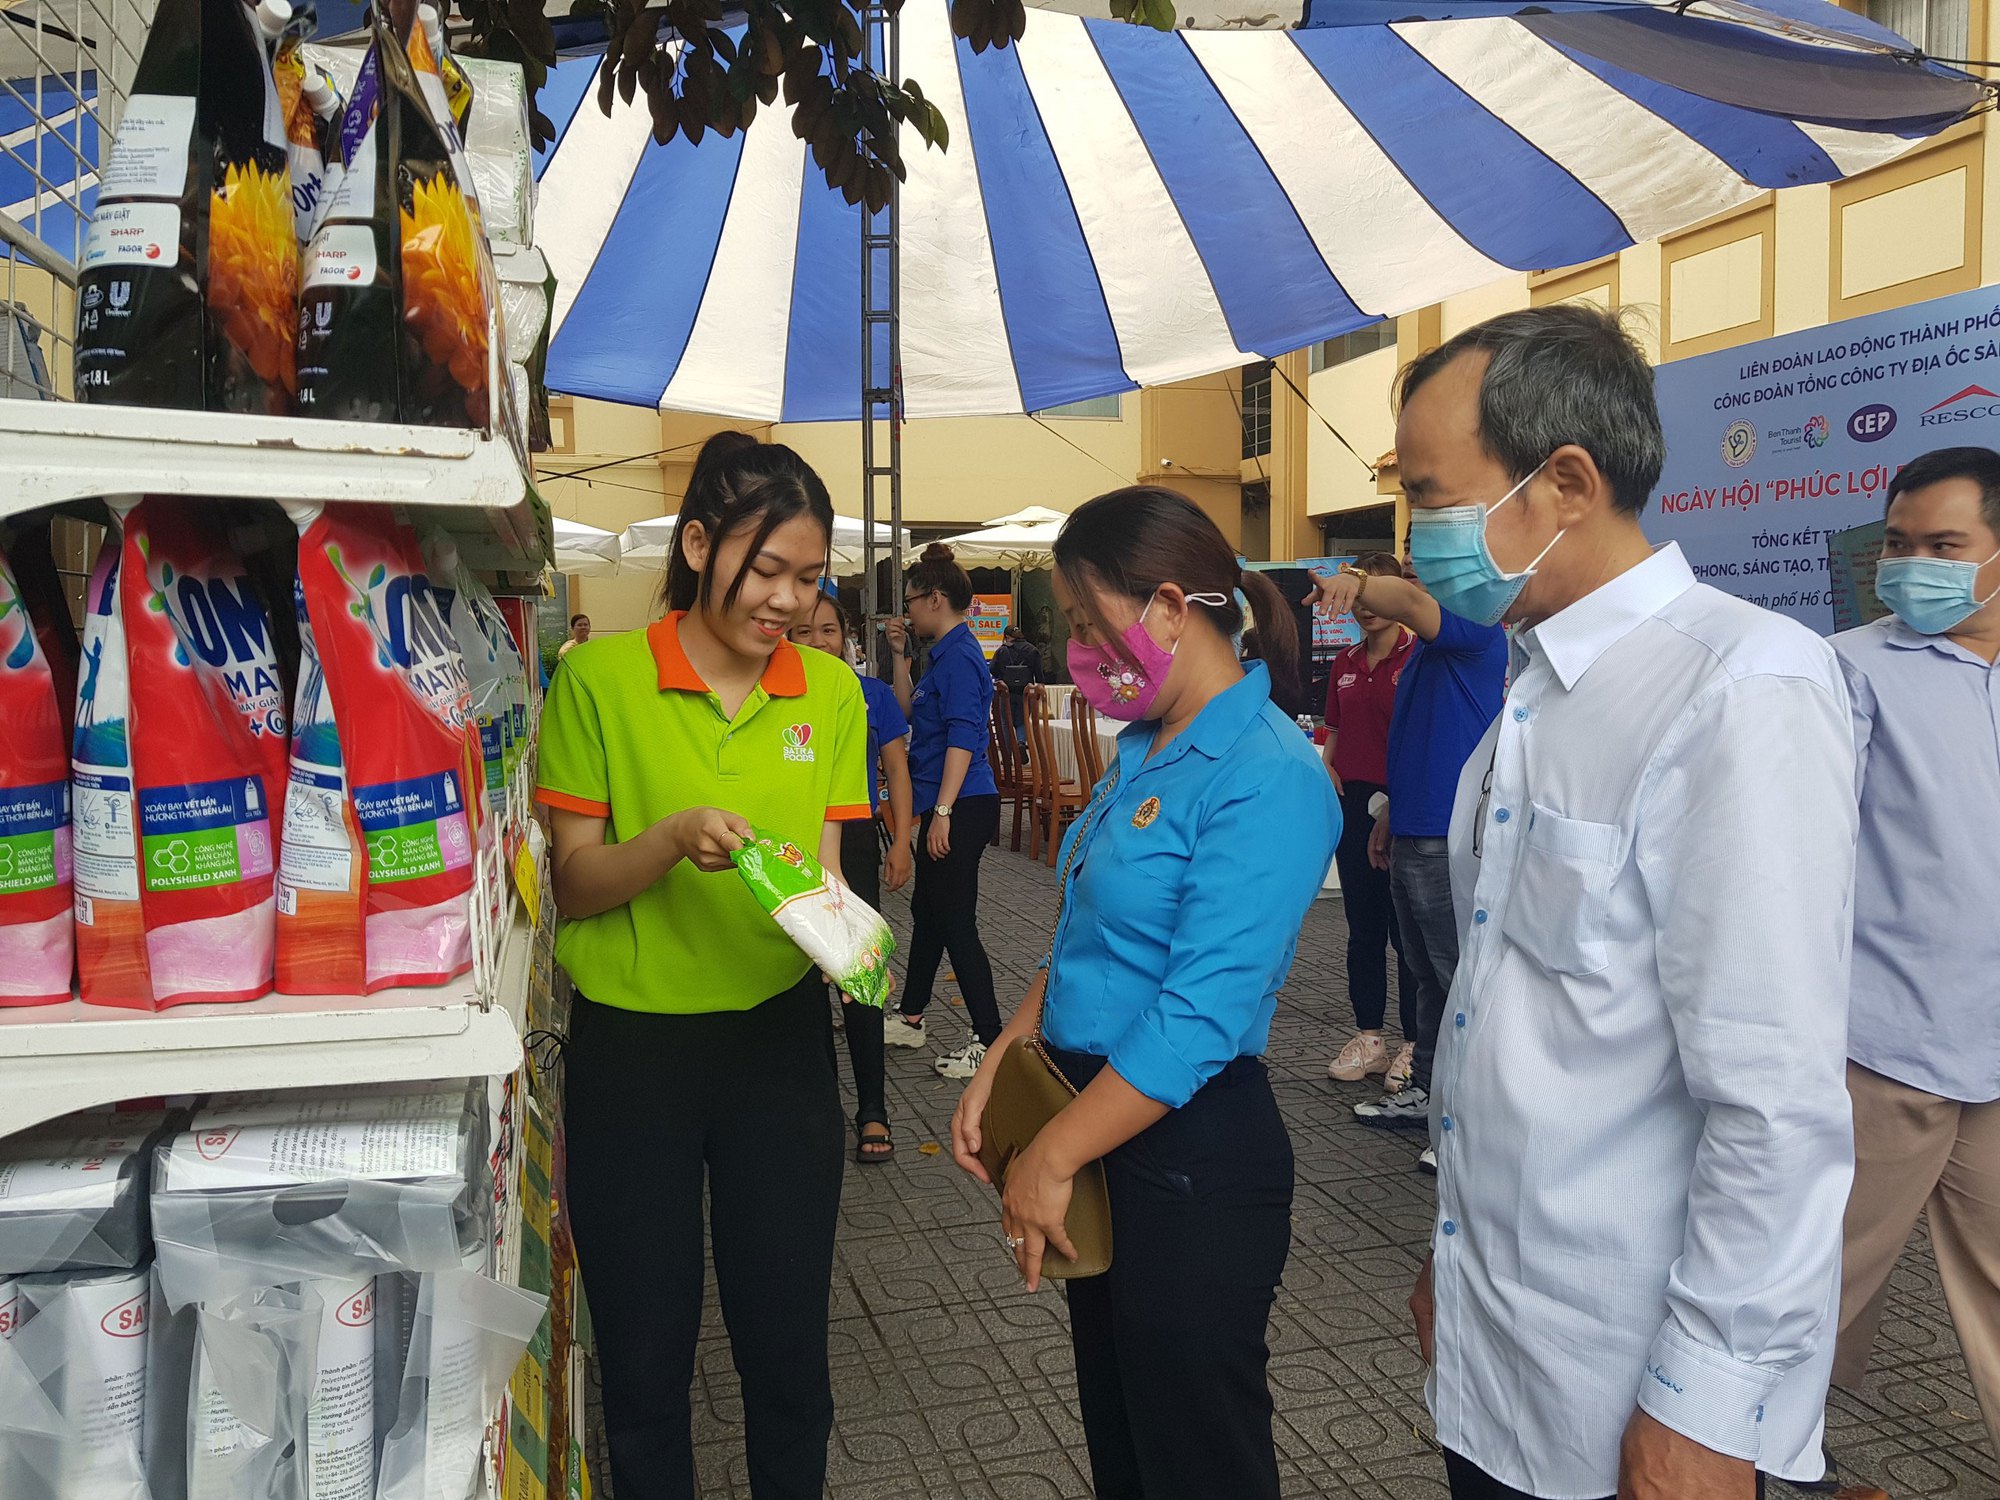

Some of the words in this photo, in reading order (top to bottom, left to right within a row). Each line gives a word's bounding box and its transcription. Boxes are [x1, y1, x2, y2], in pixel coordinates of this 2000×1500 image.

[110, 228, 145, 237] SHARP
[118, 245, 142, 253] FAGOR
[320, 267, 345, 275] FAGOR
[1740, 360, 1769, 380] LIÊN
[1772, 351, 1814, 374] ĐOÀN
[1817, 346, 1847, 364] LAO
[1850, 335, 1896, 358] ĐỘNG
[1900, 321, 1960, 347] THÀNH
[1964, 304, 2000, 333] PHỐ
[1713, 393, 1751, 411] CÔNG
[1753, 382, 1797, 403] ĐOÀN
[1797, 372, 1838, 395] TỔNG
[1840, 363, 1885, 386] CÔNG
[1889, 360, 1910, 378] TY
[1912, 354, 1942, 376] ĐỊA
[1945, 345, 1971, 367] ỐC
[1853, 411, 1890, 435] CEP
[1767, 430, 1781, 439] Ben
[1781, 427, 1802, 436] Thanh
[1780, 436, 1802, 446] Tourist
[1661, 487, 1717, 514] NGÀY
[1721, 479, 1760, 512] HỘI
[1847, 464, 1888, 499] LỢI
[1752, 529, 1789, 549] TỔNG
[1792, 526, 1818, 546] KẾT
[1743, 558, 1780, 575] SÁNG
[1783, 558, 1814, 577] TẠO,
[1771, 590, 1799, 610] phố
[1801, 590, 1821, 607] Hồ
[978, 620, 1002, 629] SALE
[783, 746, 814, 755] SATRA
[784, 754, 815, 762] FOODS
[145, 803, 167, 813] XOÁY
[168, 802, 183, 811] BAY
[184, 797, 199, 809] VẾT
[375, 800, 389, 808] BAY
[390, 795, 406, 806] VẾT
[145, 811, 178, 822] HƯƠNG
[178, 810, 202, 819] THƠM
[385, 805, 407, 816] THƠM
[194, 843, 215, 854] CÔNG
[402, 840, 420, 849] CÔNG
[195, 859, 220, 870] KHÁNG
[369, 867, 417, 879] OLYSHIELD
[419, 861, 441, 872] XANH
[0, 877, 31, 888] SHIELD
[33, 873, 54, 884] XANH
[151, 873, 211, 887] POLYSHIELD
[212, 869, 237, 880] XANH
